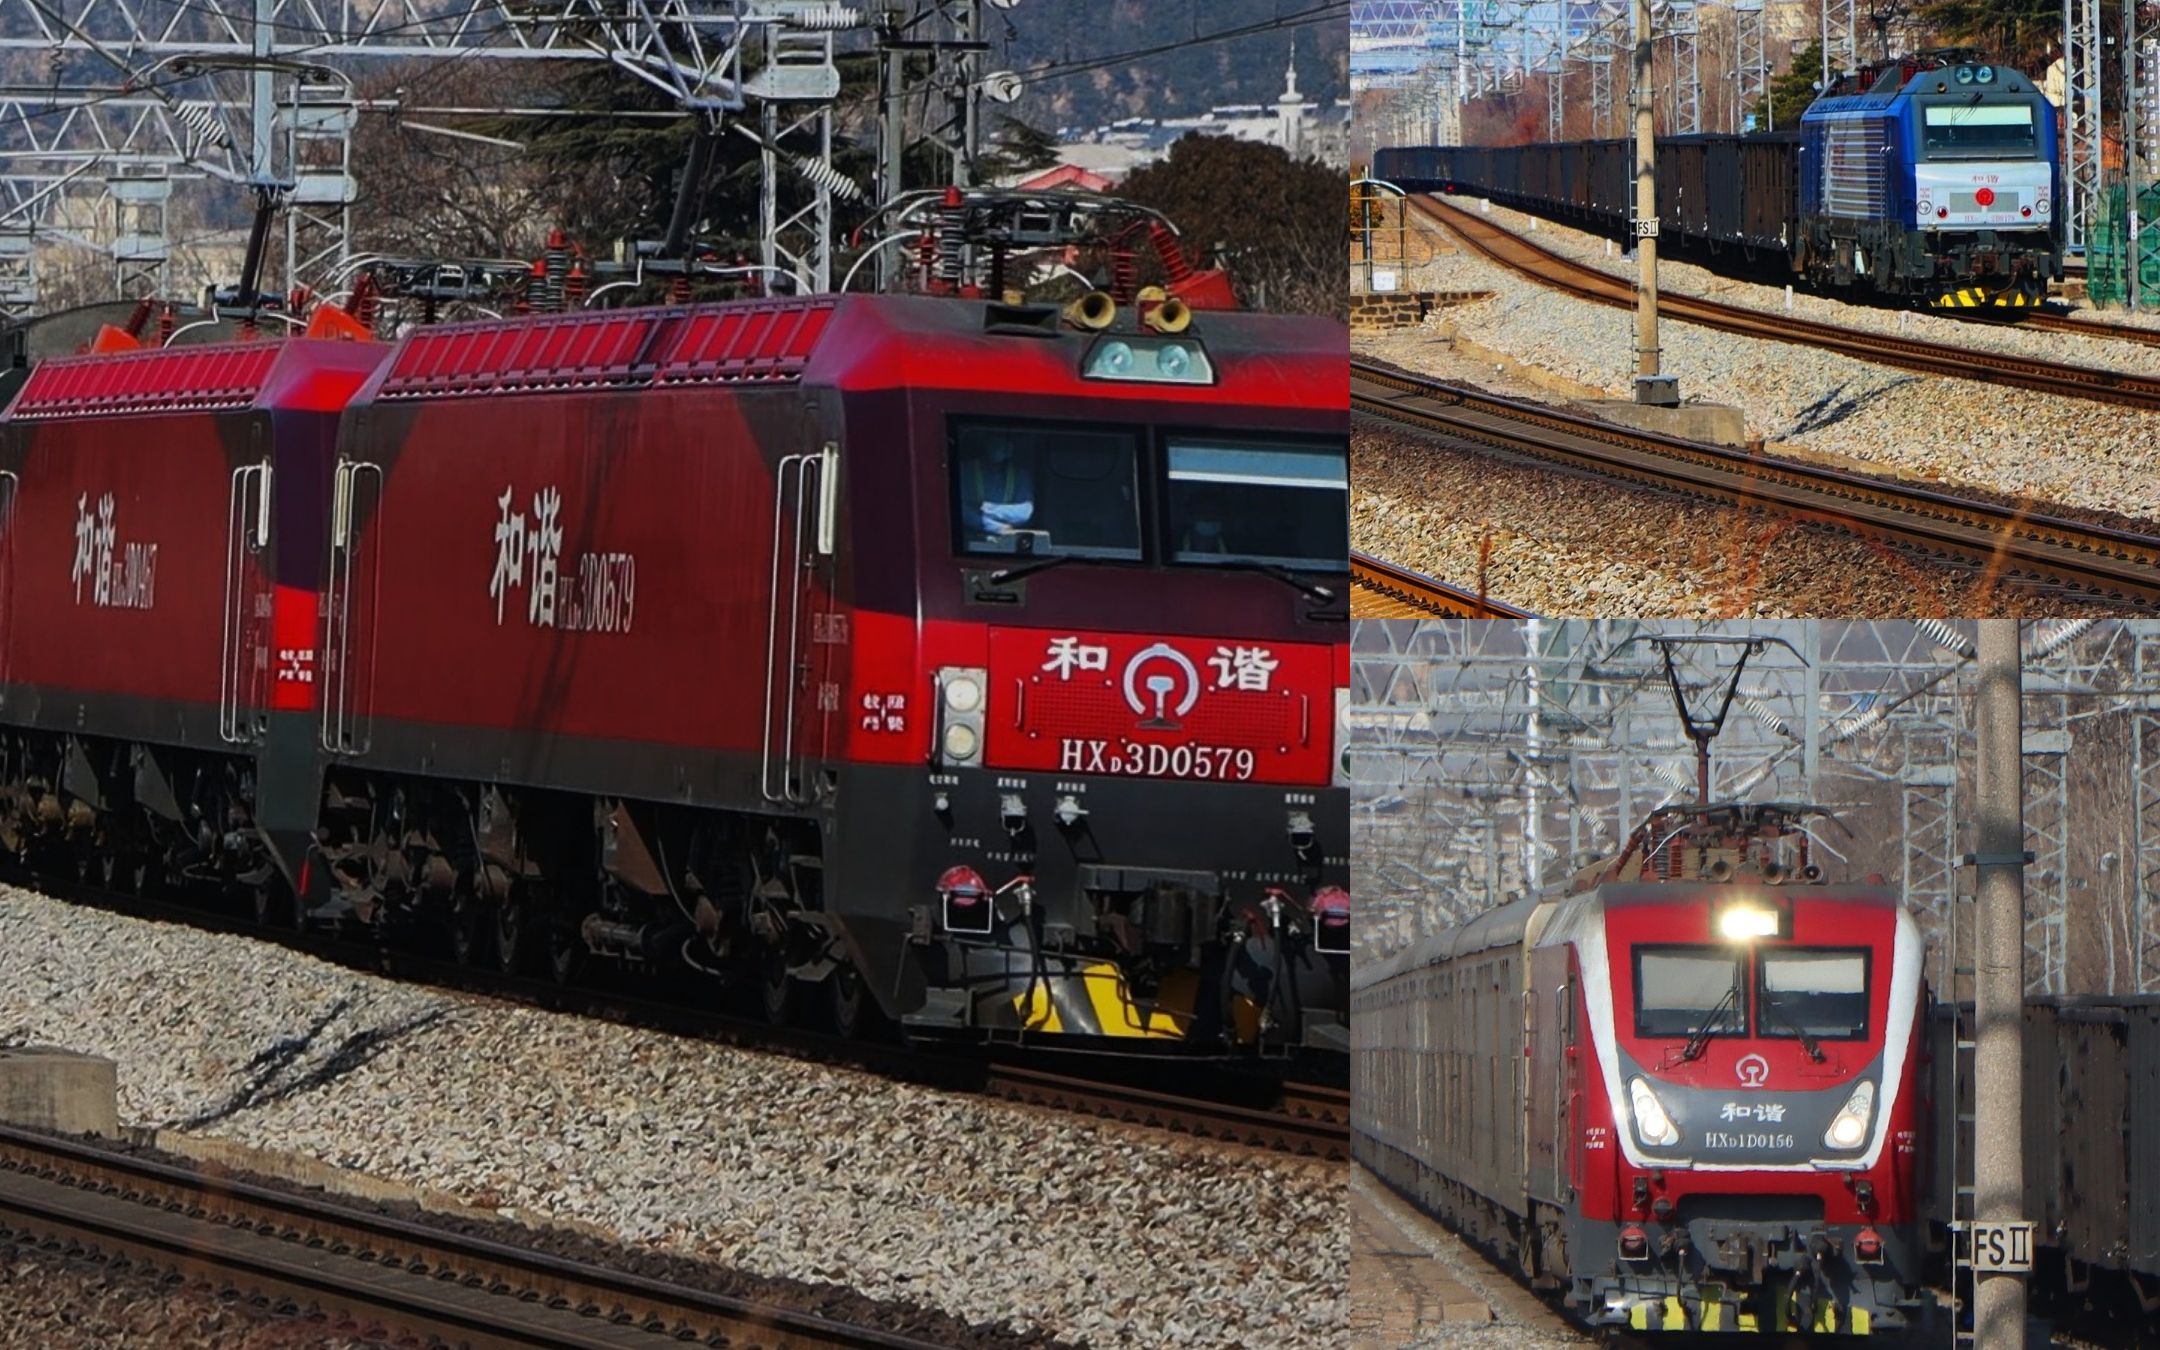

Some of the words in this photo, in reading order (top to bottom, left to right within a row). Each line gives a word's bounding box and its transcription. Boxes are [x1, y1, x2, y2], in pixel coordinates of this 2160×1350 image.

[72, 491, 116, 607] 和谐
[490, 484, 564, 629] 和谐
[1060, 738, 1255, 781] HXD3D0579
[1720, 1102, 1787, 1123] 和谐
[1705, 1132, 1795, 1149] HXD1D0156
